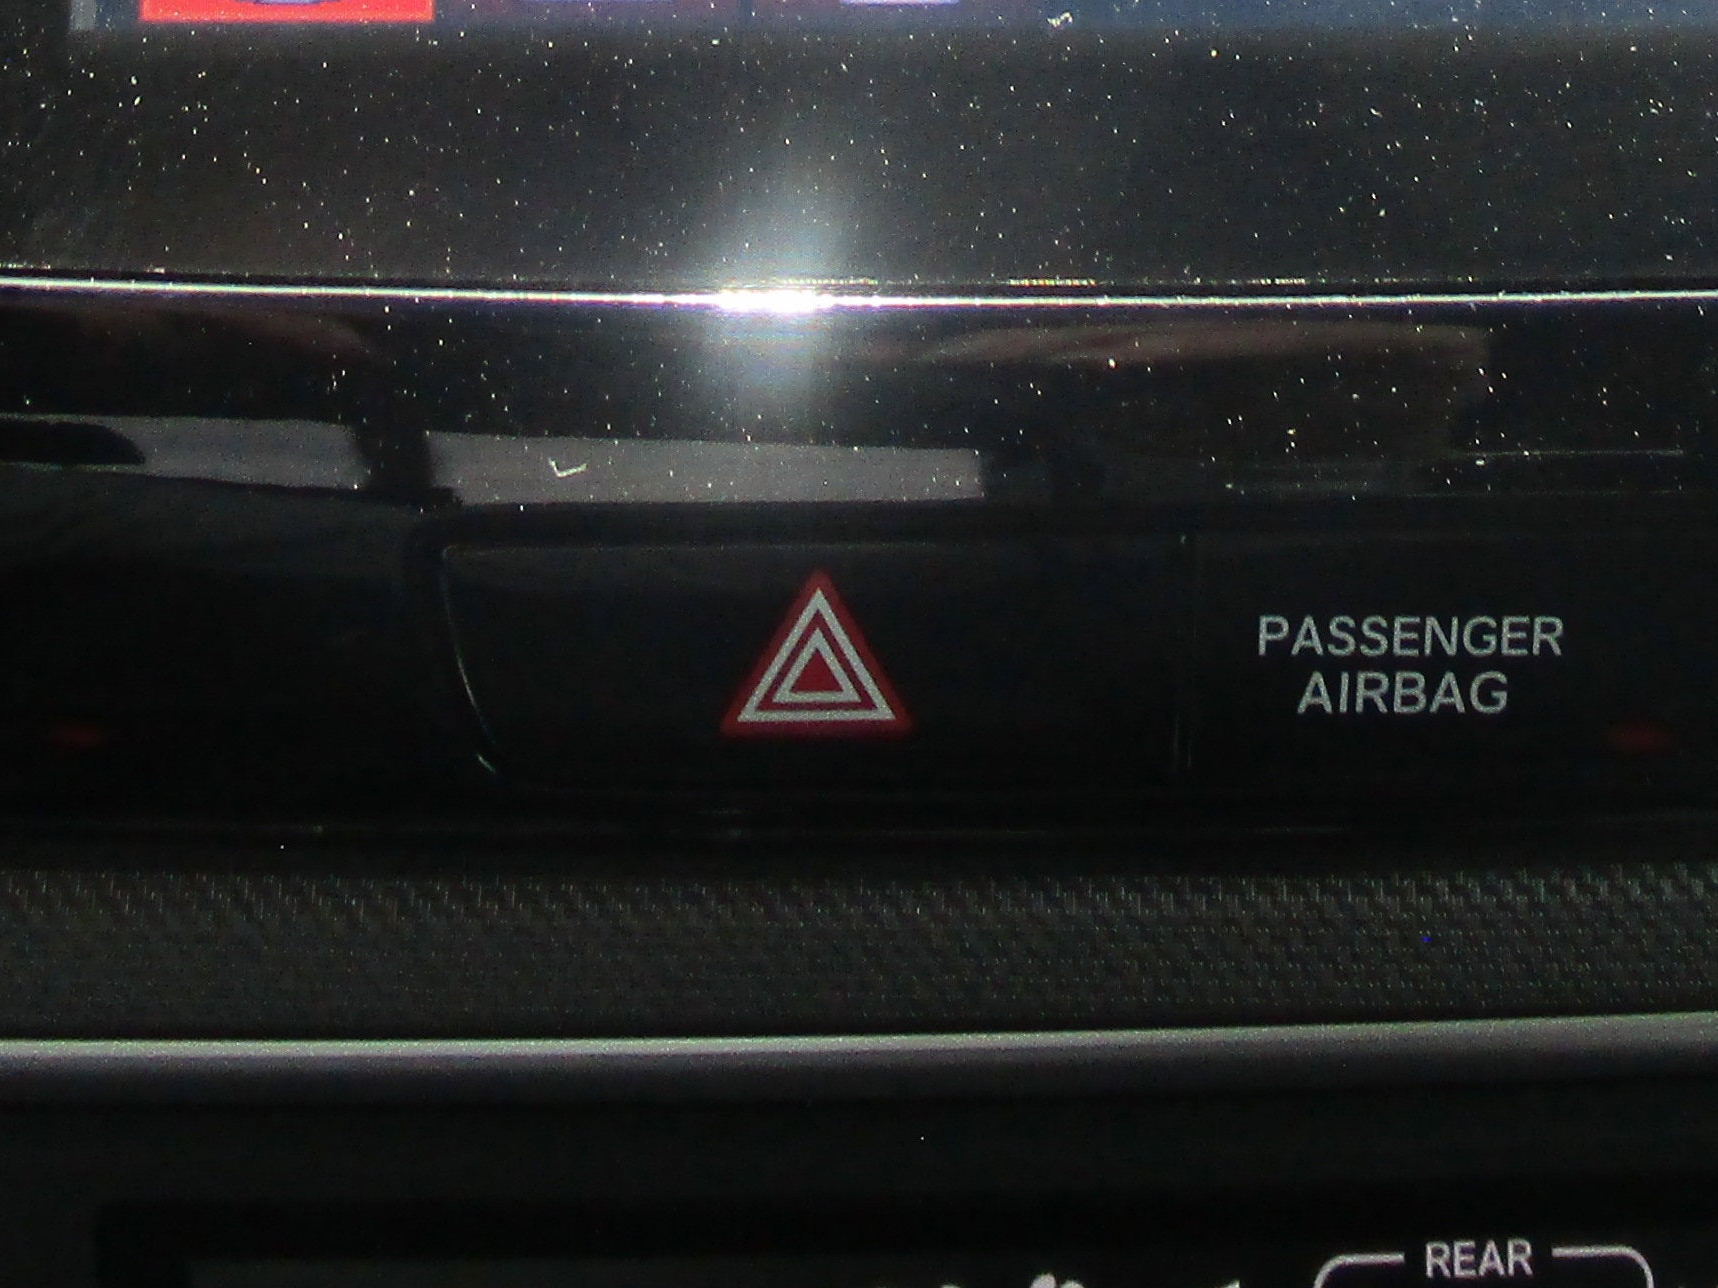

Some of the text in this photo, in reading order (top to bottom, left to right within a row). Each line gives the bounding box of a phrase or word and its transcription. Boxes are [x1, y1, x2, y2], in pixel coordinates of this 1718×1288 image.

[1257, 613, 1565, 658] PASSENGER
[1296, 670, 1510, 715] AIRBAG
[1424, 1238, 1534, 1279] REAR
